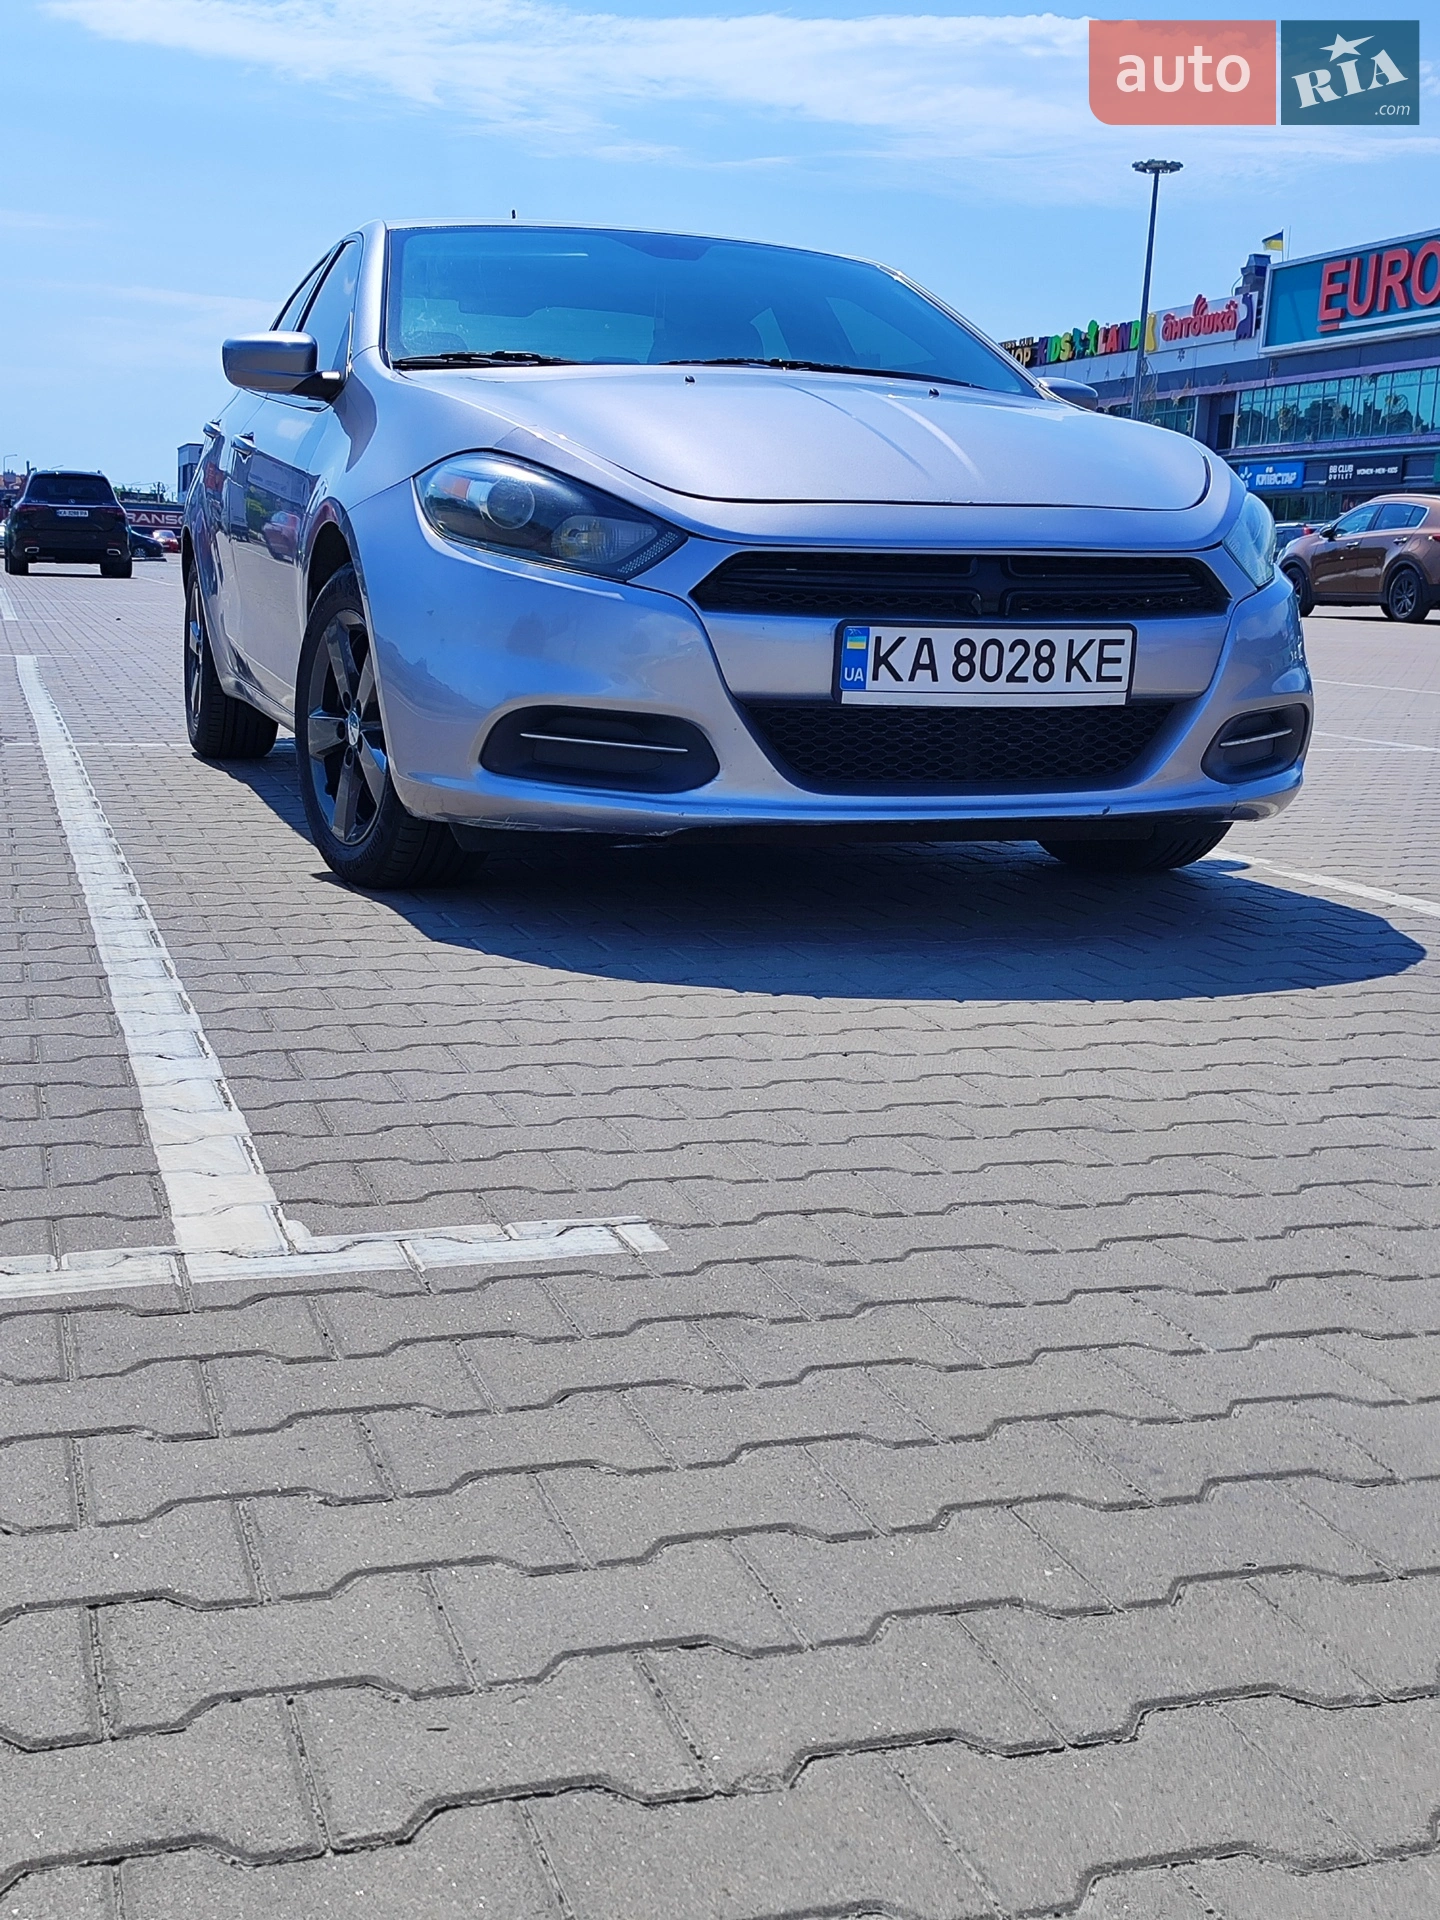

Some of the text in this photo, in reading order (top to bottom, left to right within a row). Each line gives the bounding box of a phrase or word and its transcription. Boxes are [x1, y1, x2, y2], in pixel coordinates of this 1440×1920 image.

[1037, 319, 1141, 366] KIDS LAND
[1338, 464, 1353, 473] CLUB
[844, 667, 864, 682] UA
[871, 635, 1126, 684] KA 8028 KE
